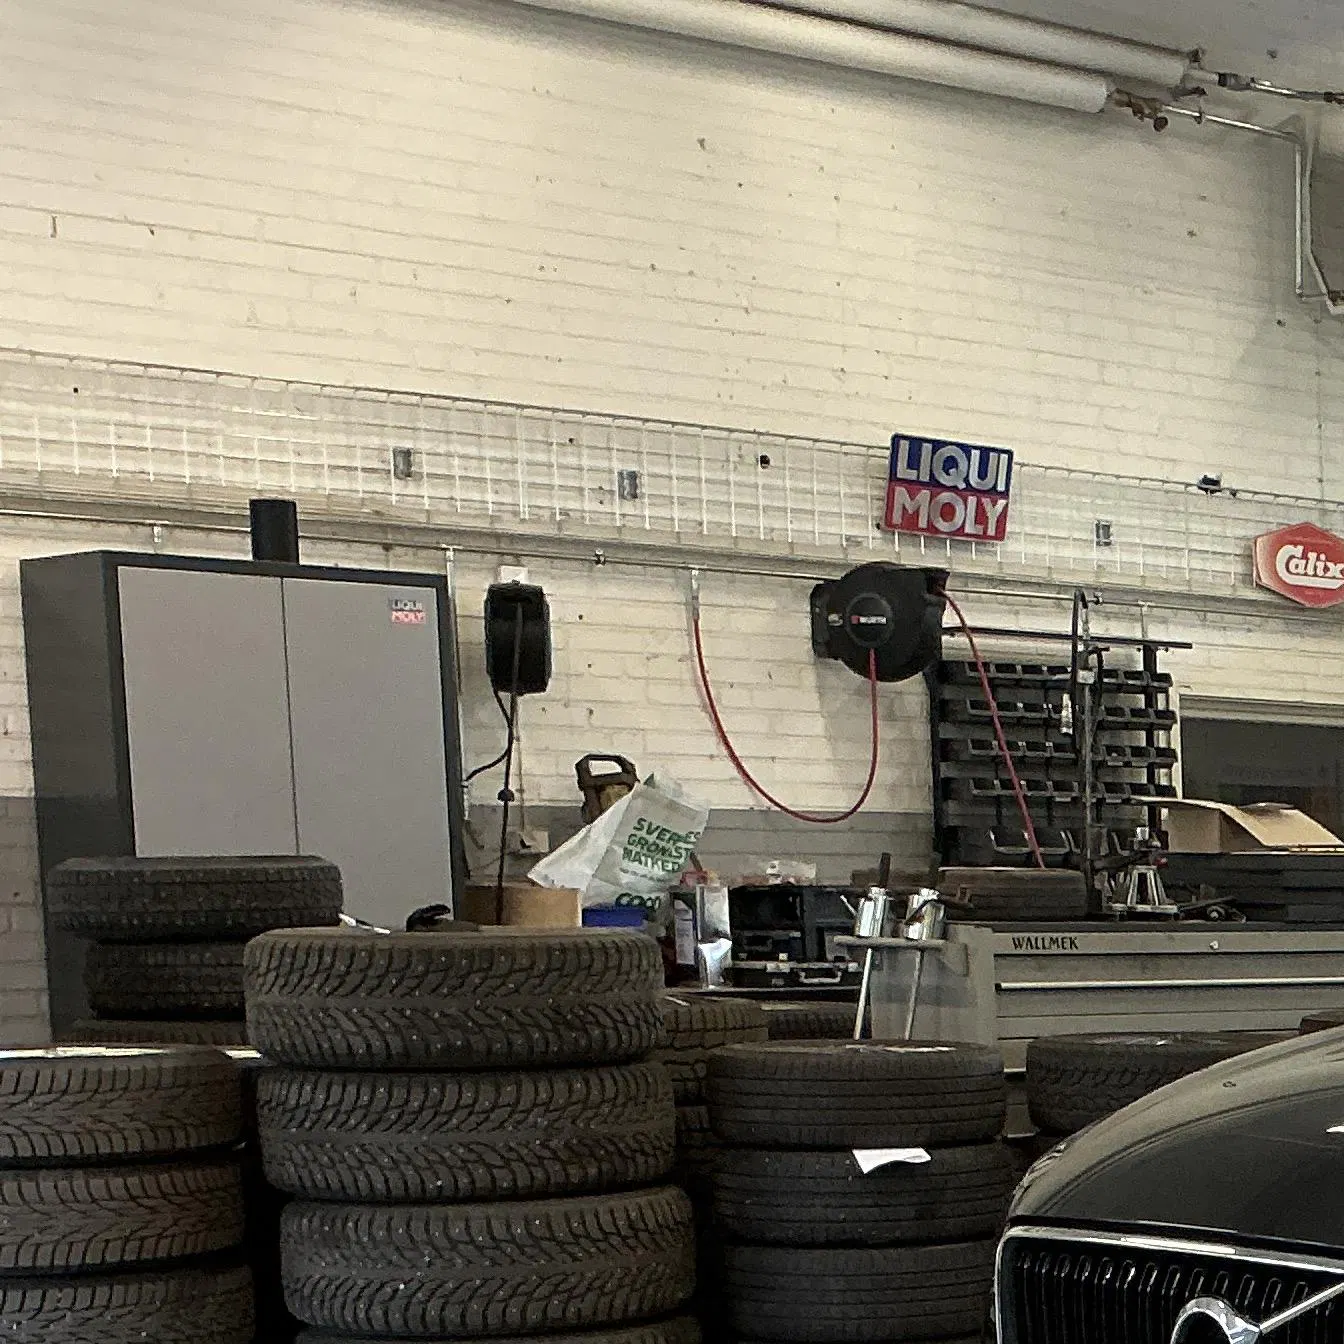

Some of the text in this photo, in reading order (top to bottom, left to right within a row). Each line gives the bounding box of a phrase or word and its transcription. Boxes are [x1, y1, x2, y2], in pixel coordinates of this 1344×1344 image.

[897, 439, 1009, 492] LIQUI
[892, 486, 1008, 537] MOLY
[1011, 936, 1079, 950] WALLMEK
